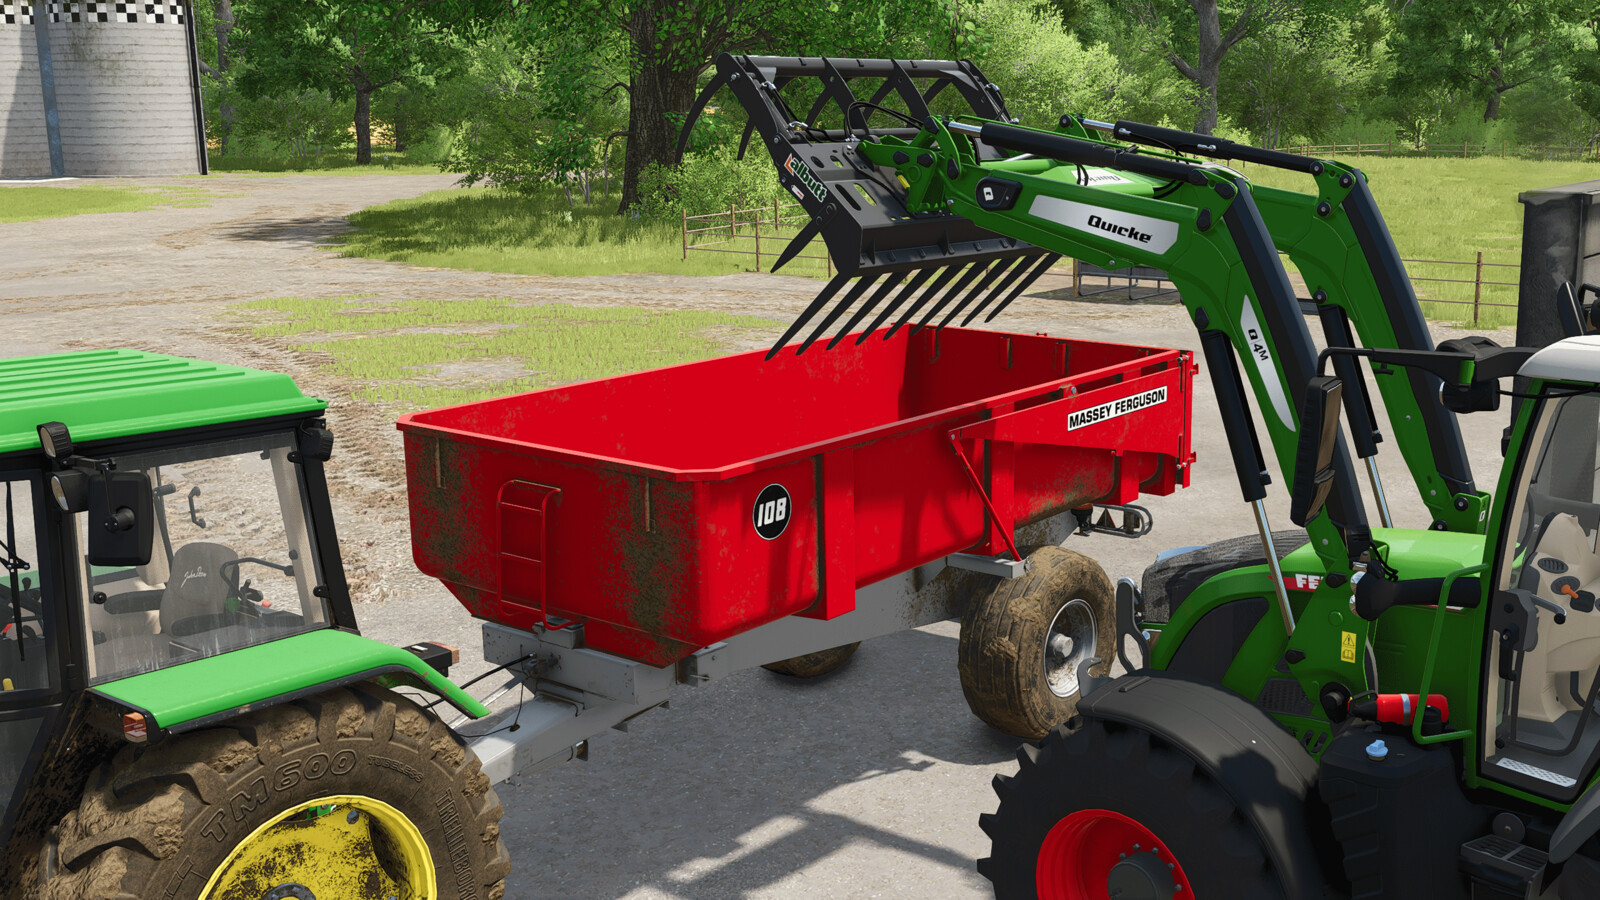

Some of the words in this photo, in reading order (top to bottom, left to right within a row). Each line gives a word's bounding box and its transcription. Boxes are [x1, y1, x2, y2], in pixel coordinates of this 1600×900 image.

[789, 157, 827, 203] albutt
[1088, 214, 1152, 244] Quicke
[1069, 404, 1112, 429] MASSEY
[1114, 388, 1165, 415] FERGUSON
[757, 496, 787, 528] 108
[1295, 573, 1324, 590] FE
[367, 754, 424, 783] TUBELESS
